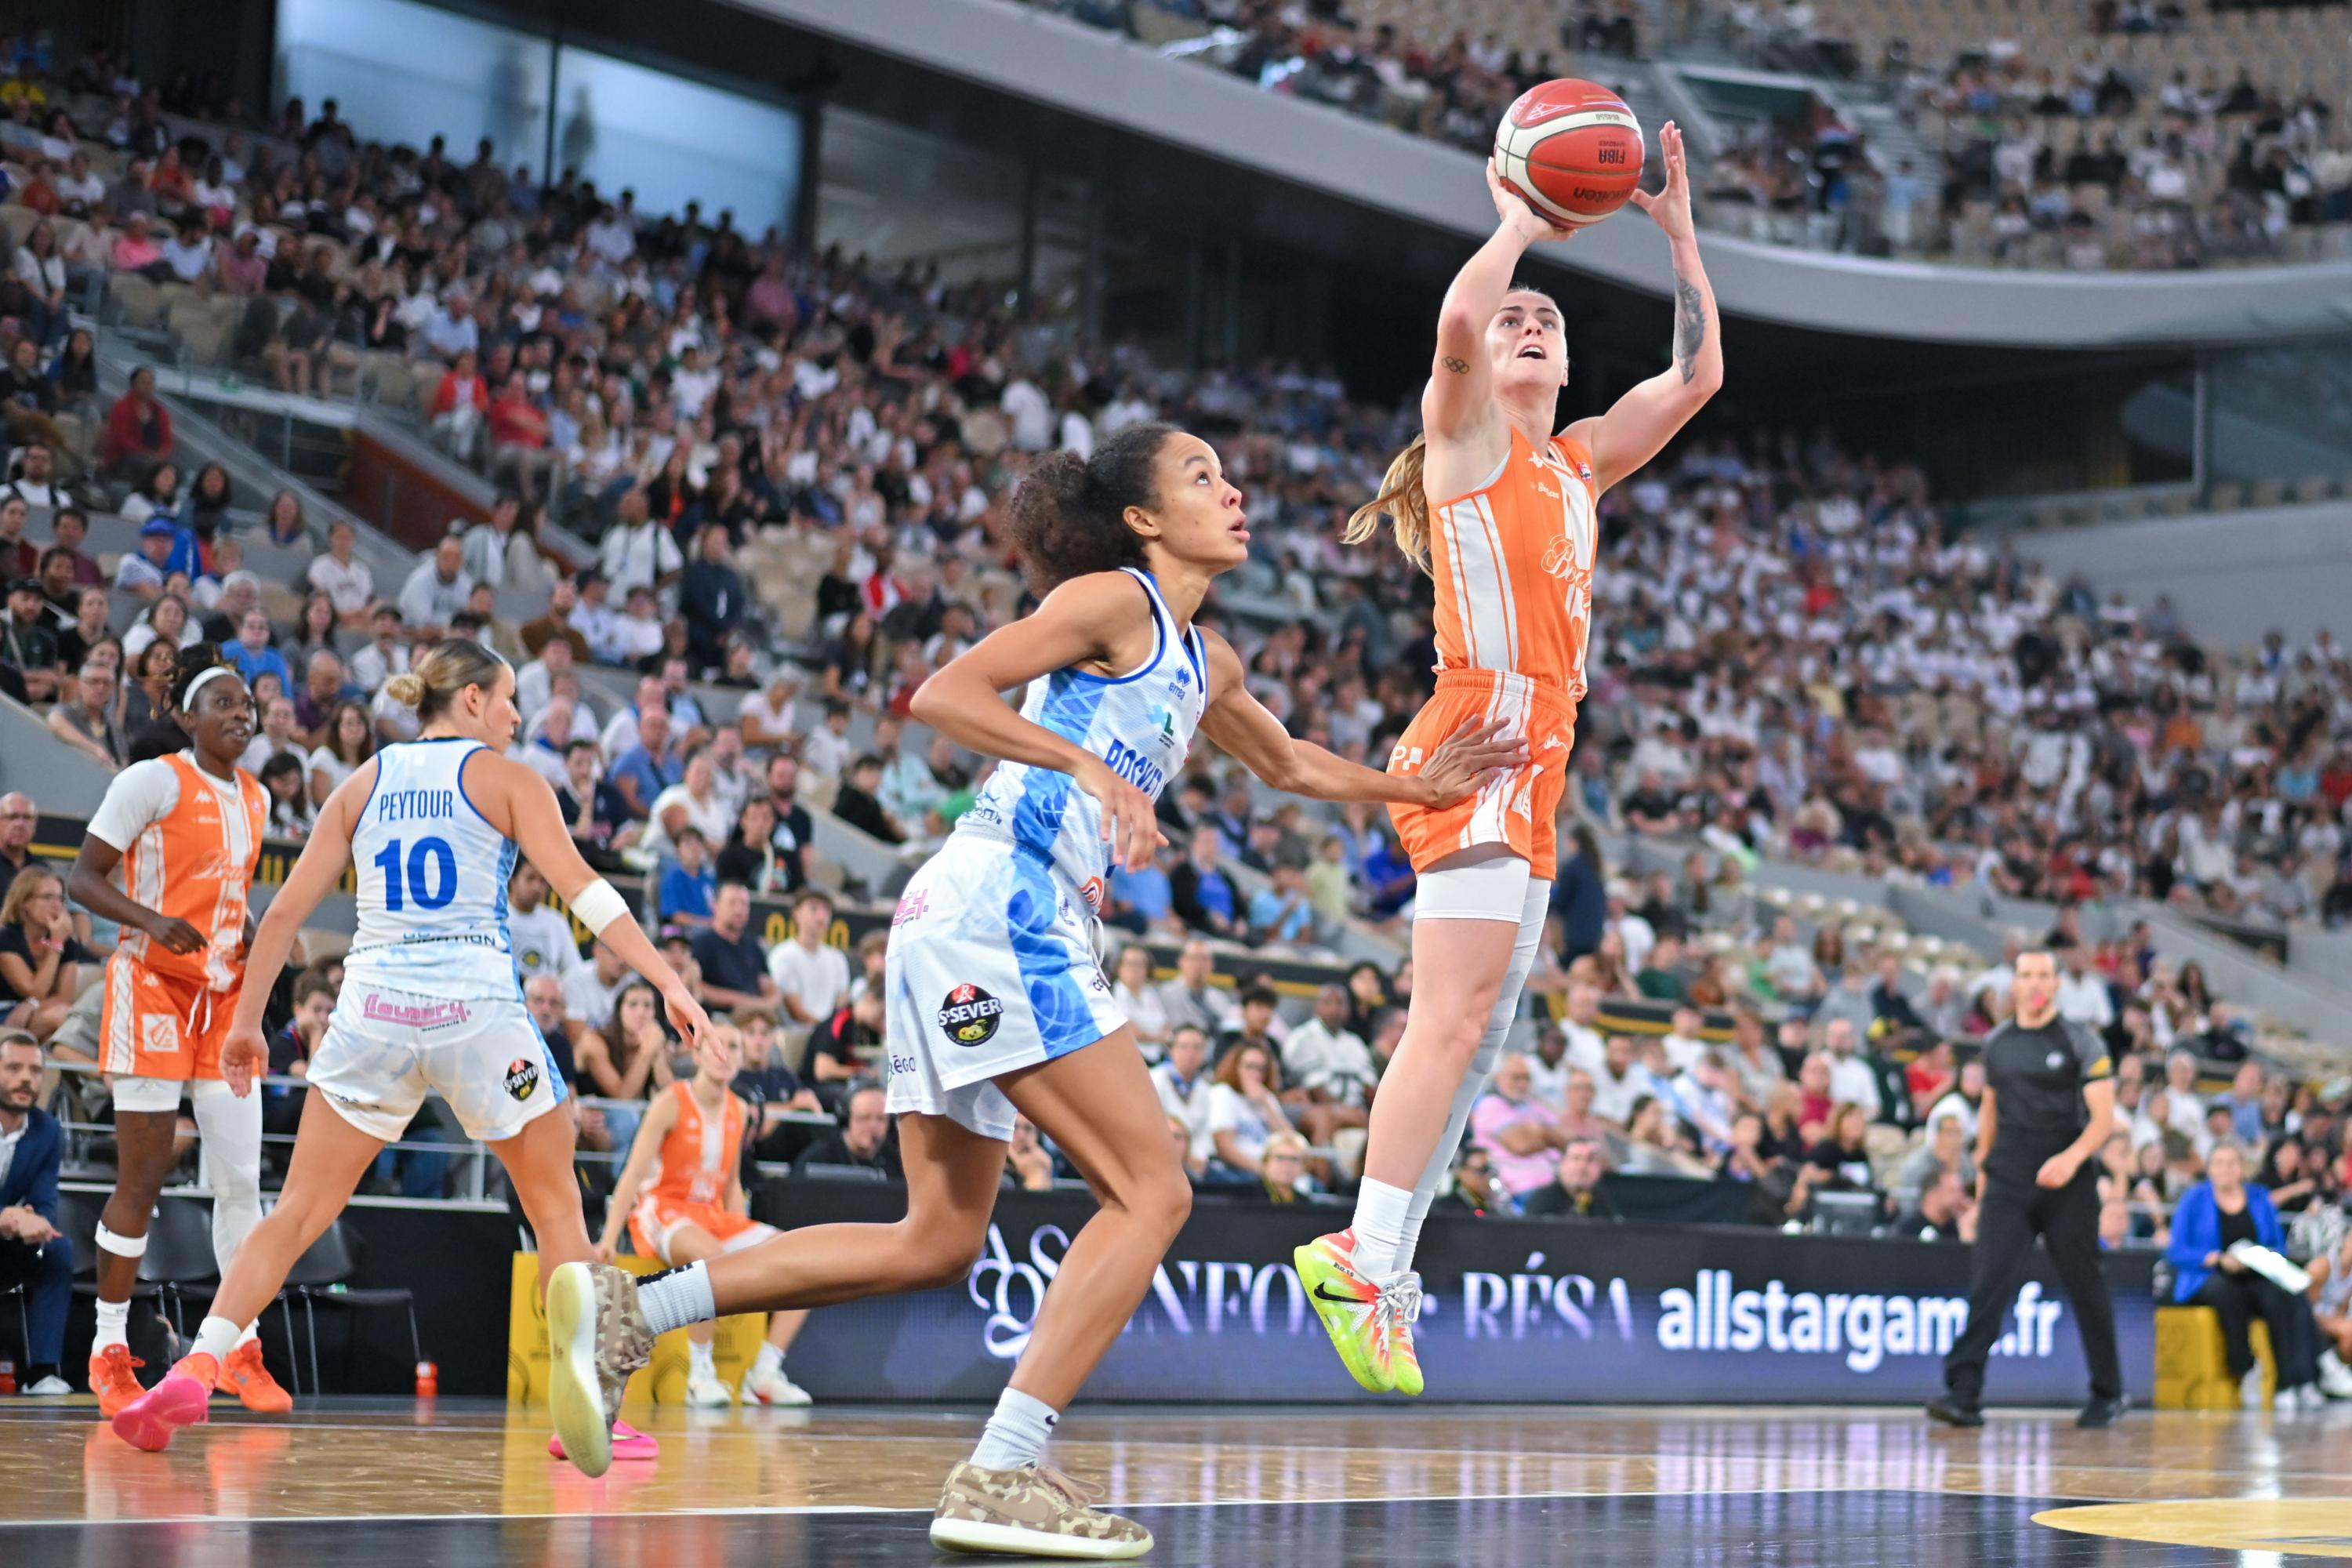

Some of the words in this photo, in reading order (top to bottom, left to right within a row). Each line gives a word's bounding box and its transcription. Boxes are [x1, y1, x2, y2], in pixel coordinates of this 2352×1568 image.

[1599, 149, 1625, 164] FIBA
[379, 789, 453, 822] PEYTOUR
[375, 835, 457, 912] 10
[1463, 1251, 1635, 1339] RÉSA
[1657, 1269, 2063, 1373] allstargam.fr
